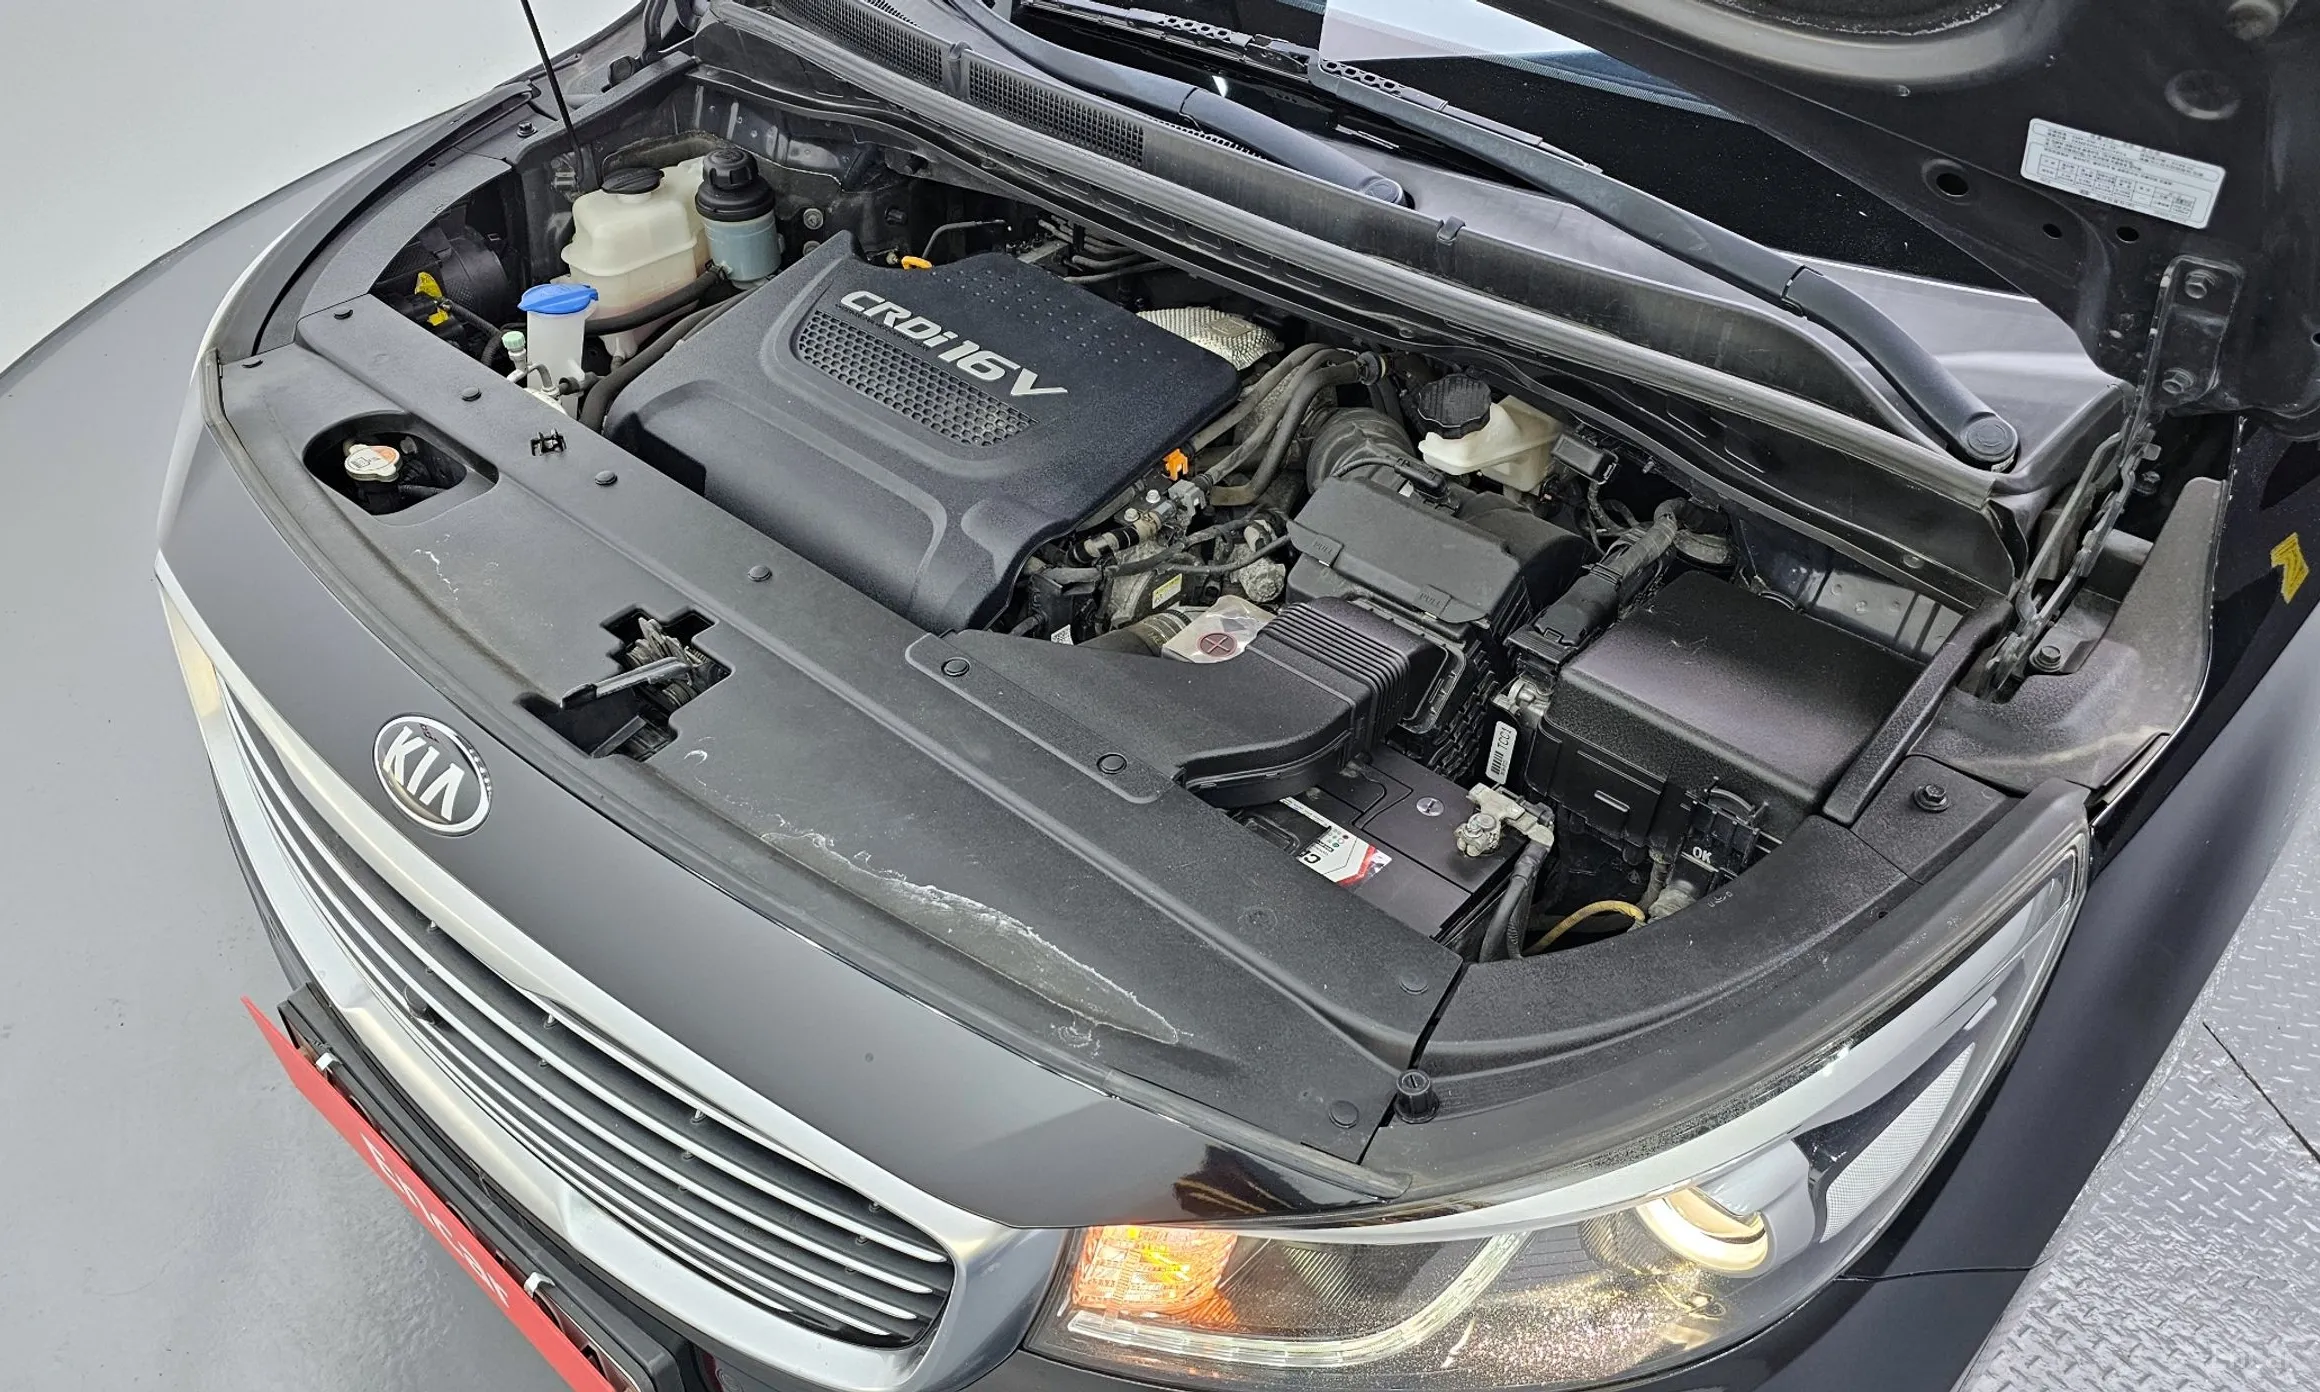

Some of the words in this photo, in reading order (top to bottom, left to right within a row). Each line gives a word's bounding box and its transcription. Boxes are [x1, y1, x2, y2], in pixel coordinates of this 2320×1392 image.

[840, 290, 958, 347] CRDi
[938, 338, 1068, 396] 16V
[383, 726, 464, 820] KIA
[1692, 846, 1712, 864] OK
